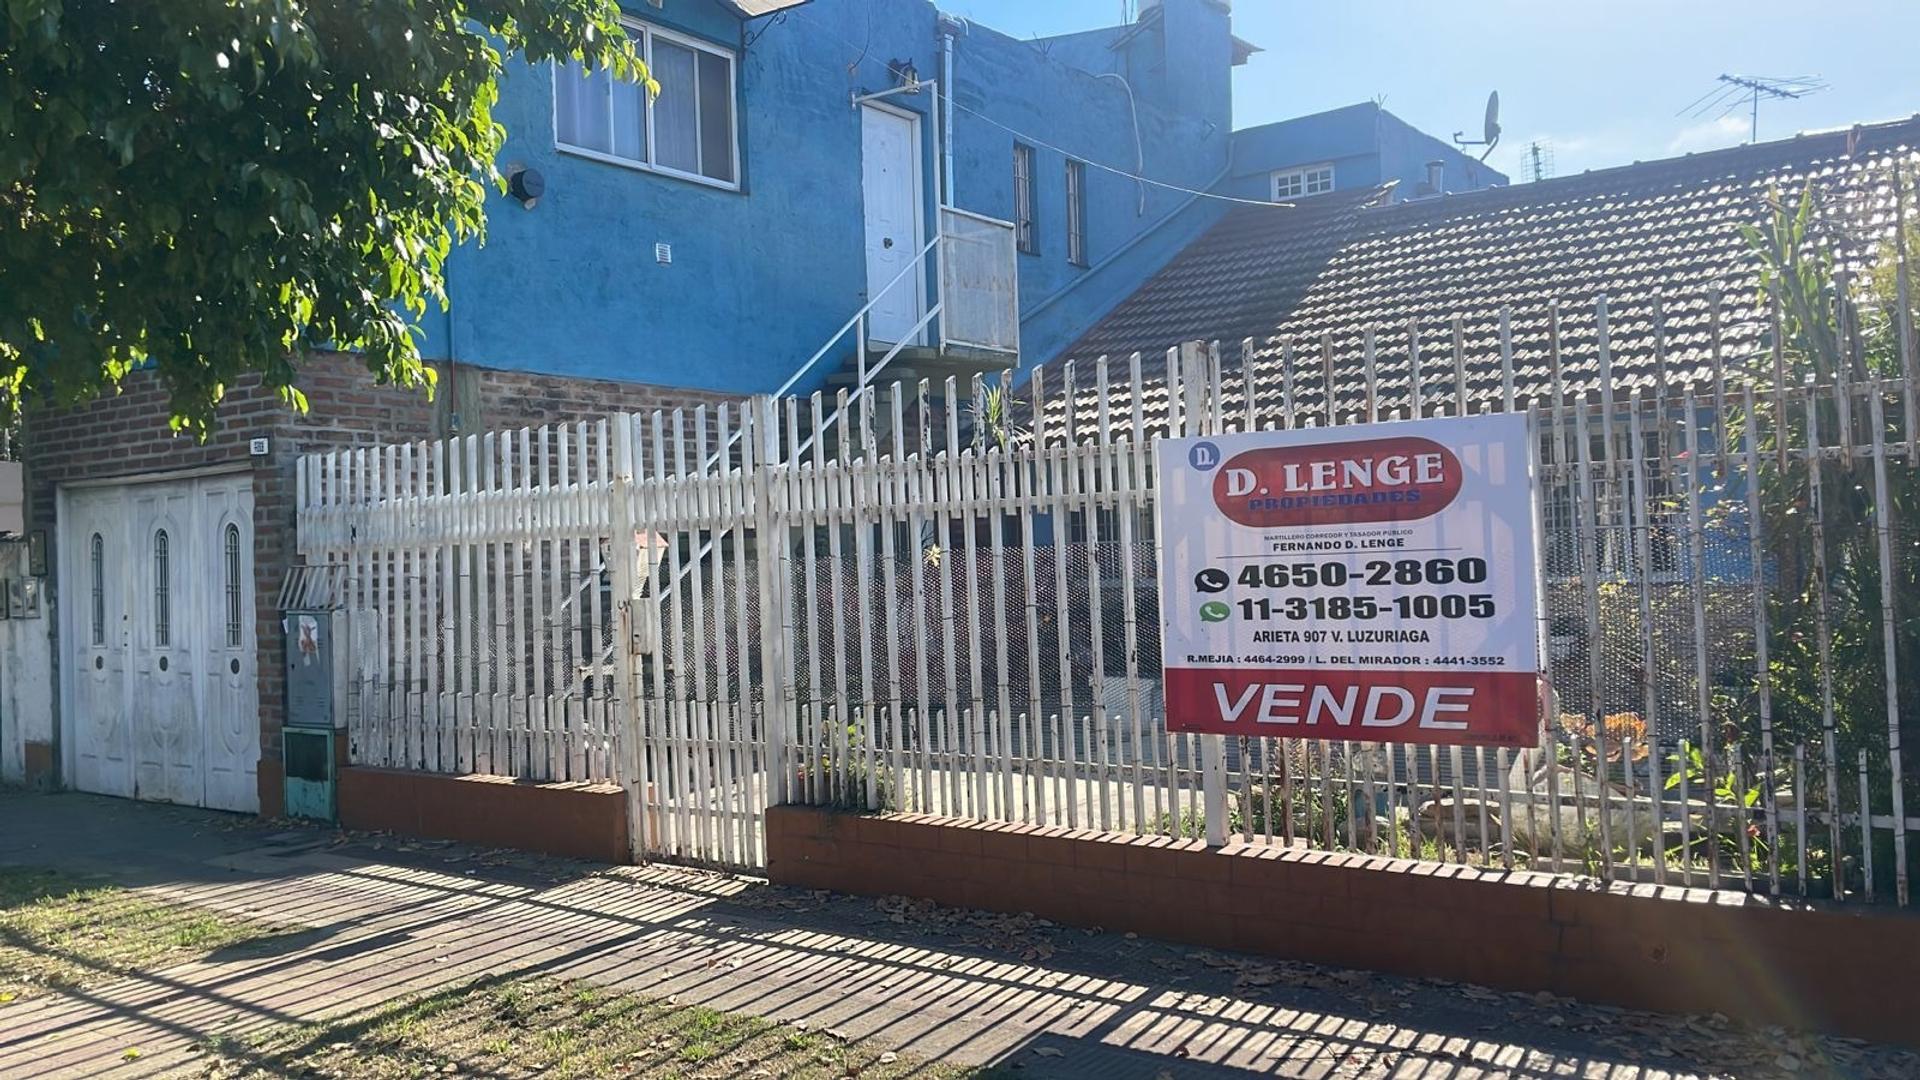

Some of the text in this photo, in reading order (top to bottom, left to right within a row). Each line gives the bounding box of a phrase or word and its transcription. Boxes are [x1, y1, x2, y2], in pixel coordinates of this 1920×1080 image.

[1225, 453, 1444, 497] D. LENGE
[1248, 489, 1421, 511] PROPIEDADES
[1273, 538, 1405, 552] FERNANDO D. LENGE
[1237, 557, 1487, 588] 4650-2860
[1237, 594, 1496, 620] 11-3185-1005
[1253, 630, 1430, 643] ARIETA 907 V. LUZURIAGA
[1187, 655, 1234, 664] R.MEJIA
[1244, 655, 1305, 664] 4464-2999
[1316, 656, 1327, 664] L.
[1331, 656, 1355, 664] DEL
[1359, 656, 1421, 665] MIRADOR
[1433, 656, 1505, 665] 4441-3552
[1212, 682, 1475, 731] VENDE
